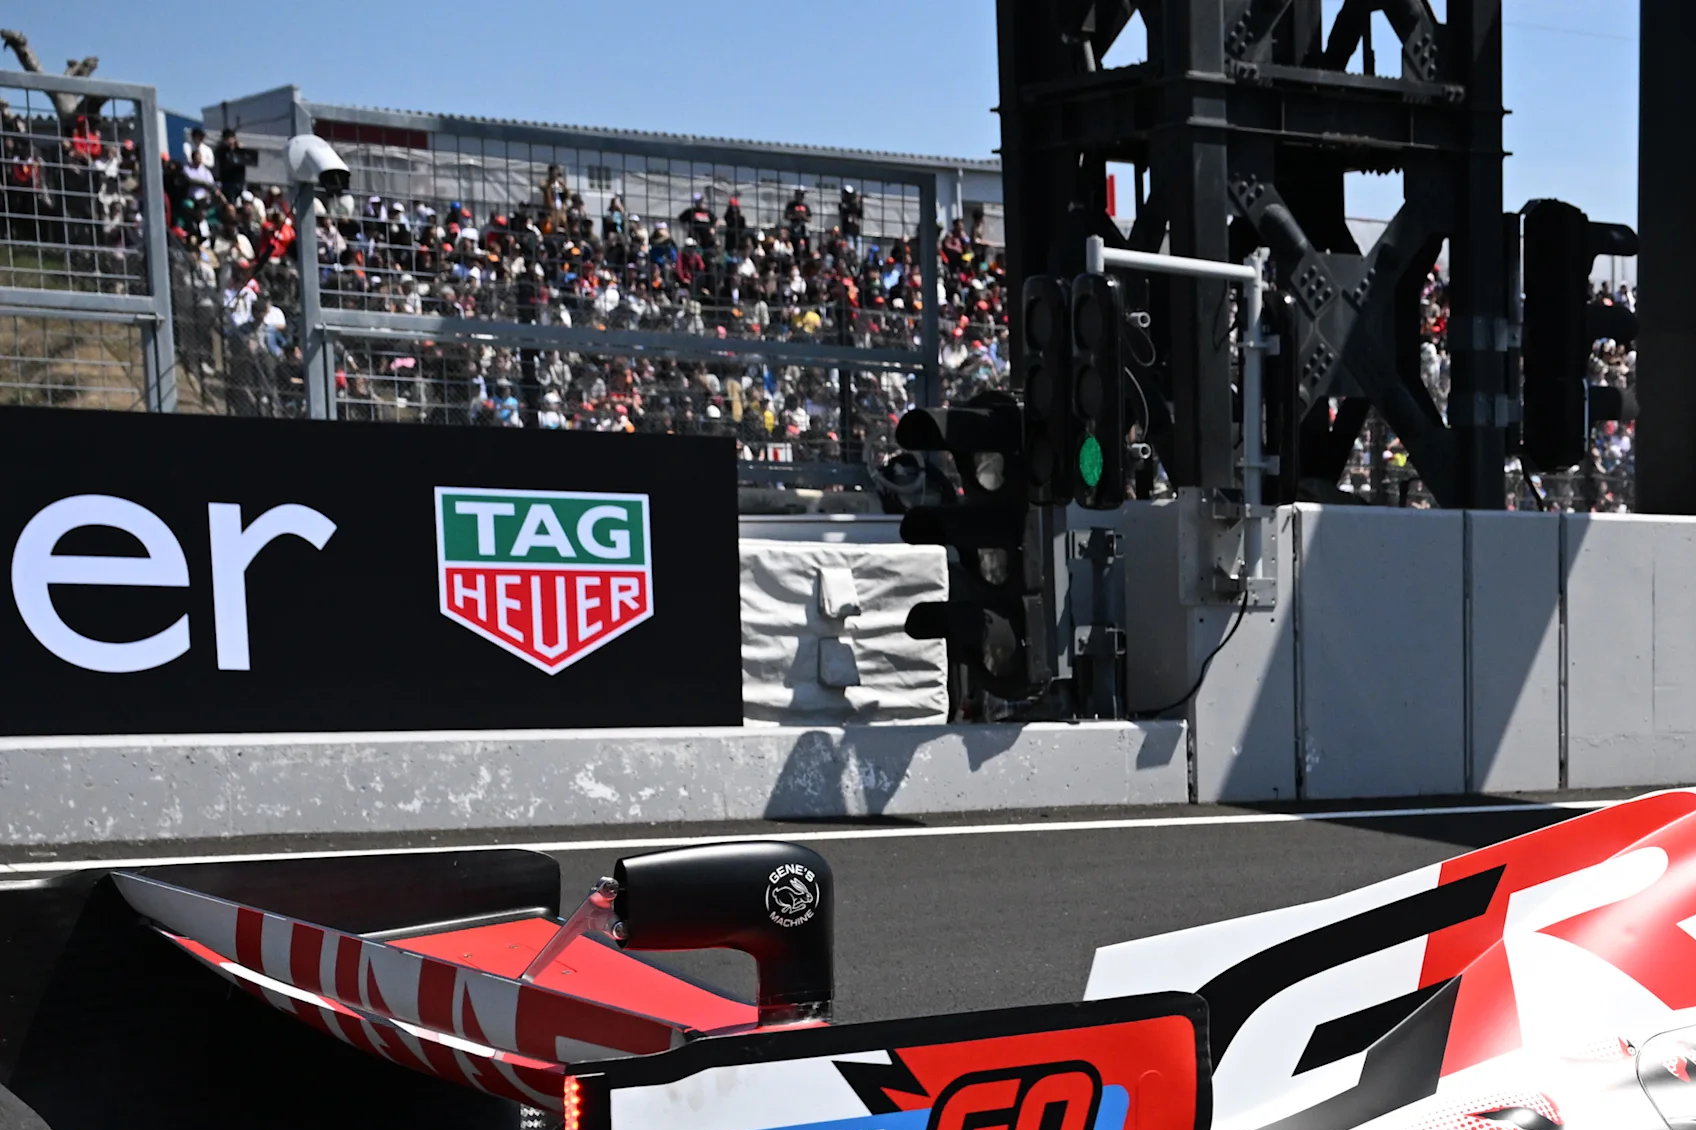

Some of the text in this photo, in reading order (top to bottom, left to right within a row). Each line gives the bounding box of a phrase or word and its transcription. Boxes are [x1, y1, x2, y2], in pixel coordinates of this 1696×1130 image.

[455, 501, 631, 560] TAG
[453, 573, 641, 657] HEUER
[769, 864, 815, 884] GENE'S
[769, 909, 814, 927] MACHINE
